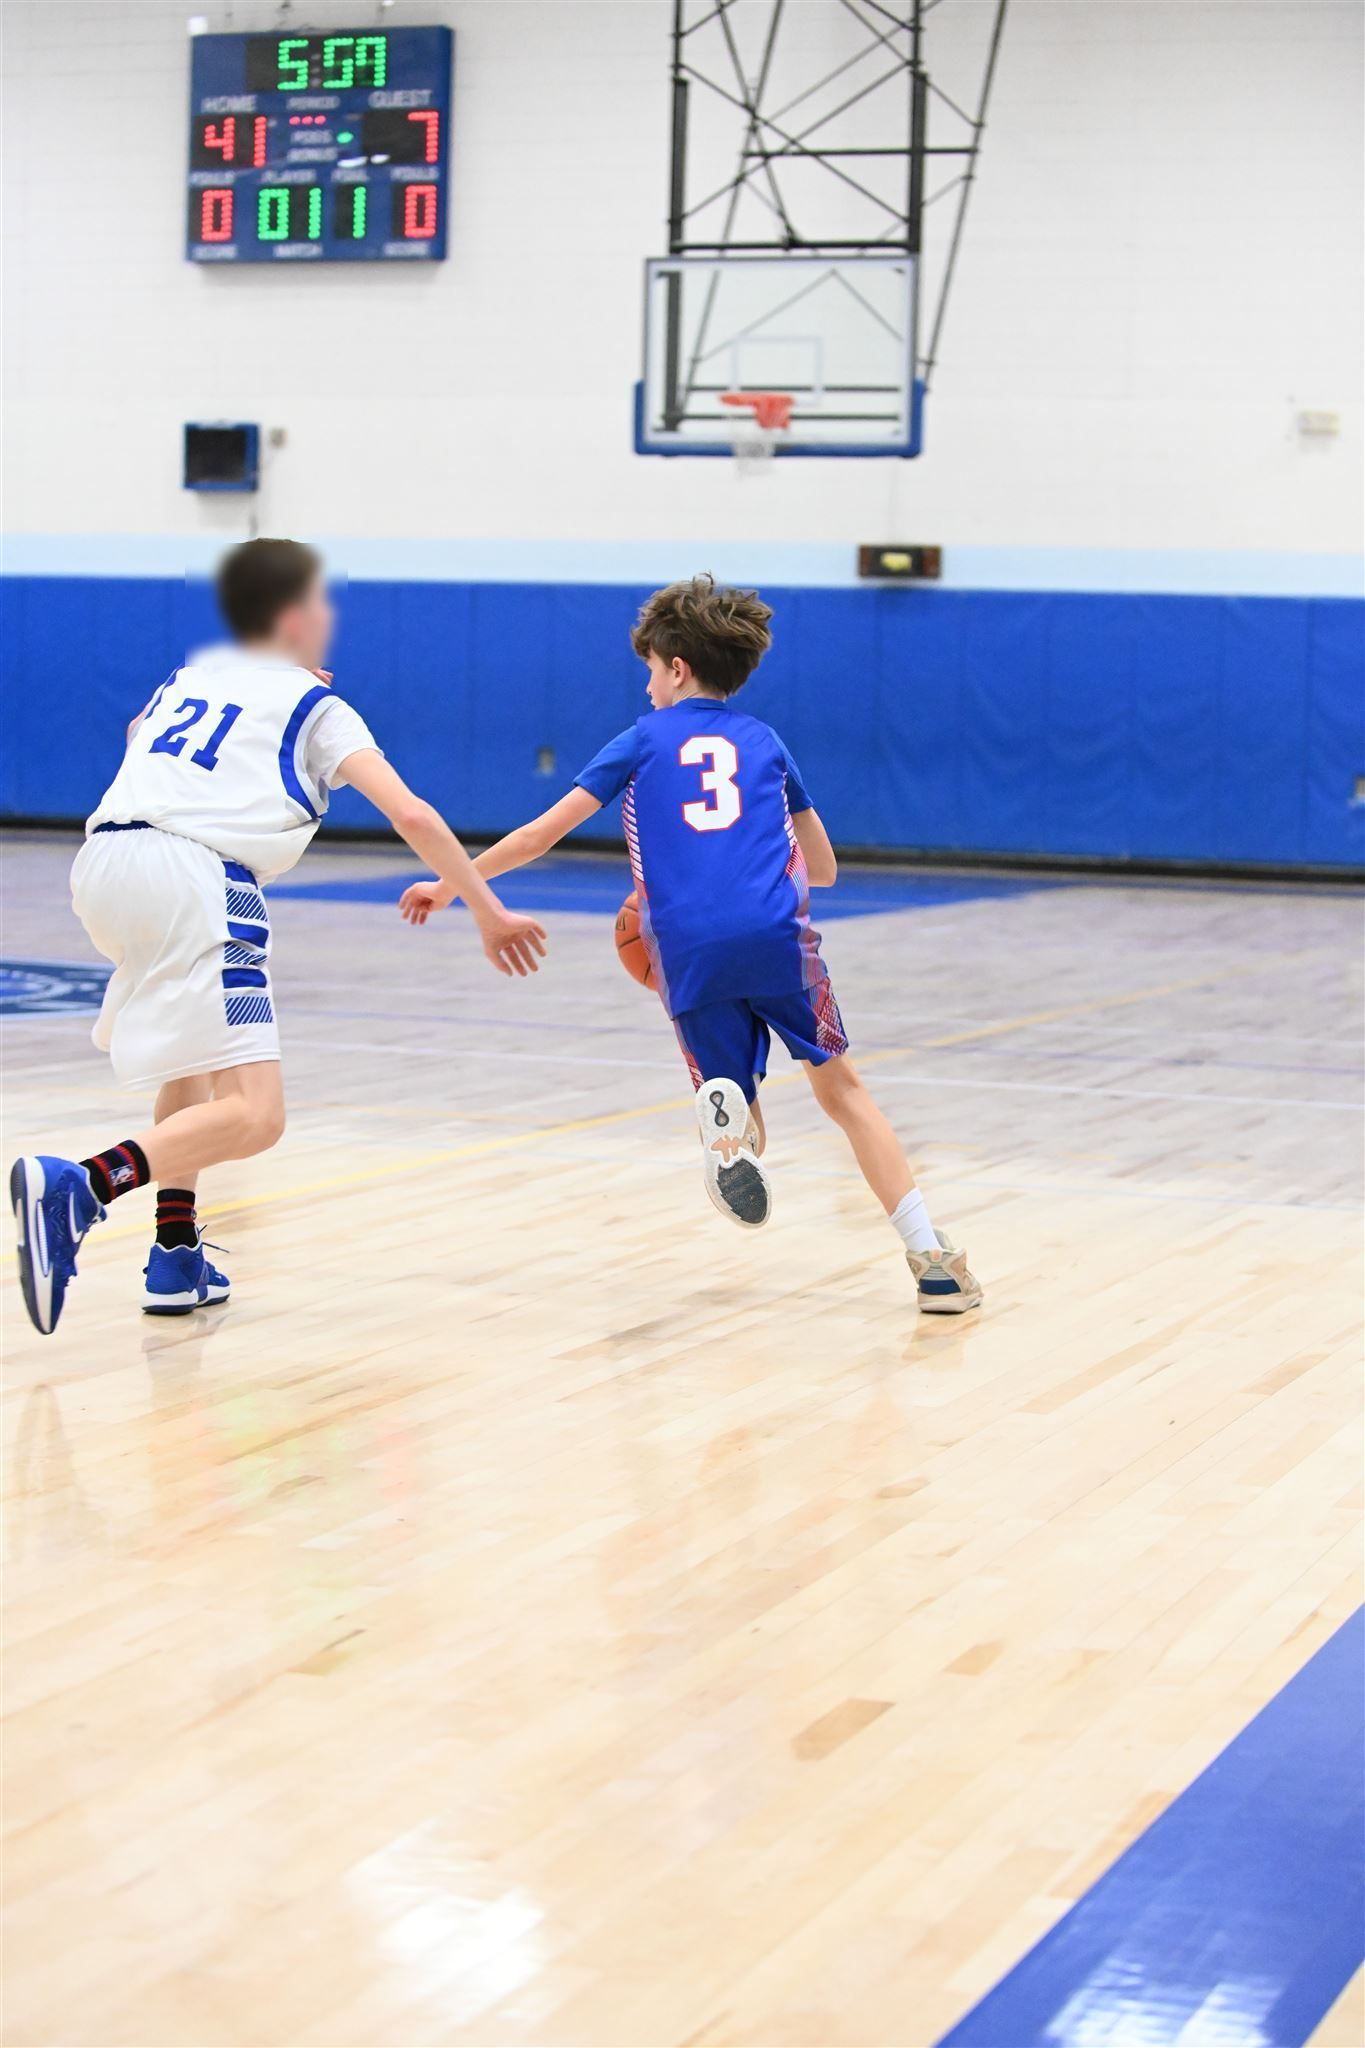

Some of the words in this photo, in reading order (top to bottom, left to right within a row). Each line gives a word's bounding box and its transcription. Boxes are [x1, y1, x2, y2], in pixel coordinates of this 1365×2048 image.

[201, 95, 258, 112] HOME
[368, 90, 432, 108] GUEST
[204, 116, 267, 168] 41
[407, 111, 439, 163] 7
[201, 188, 233, 242] 0
[404, 184, 438, 238] 0
[148, 697, 243, 771] 21
[679, 735, 742, 832] 3
